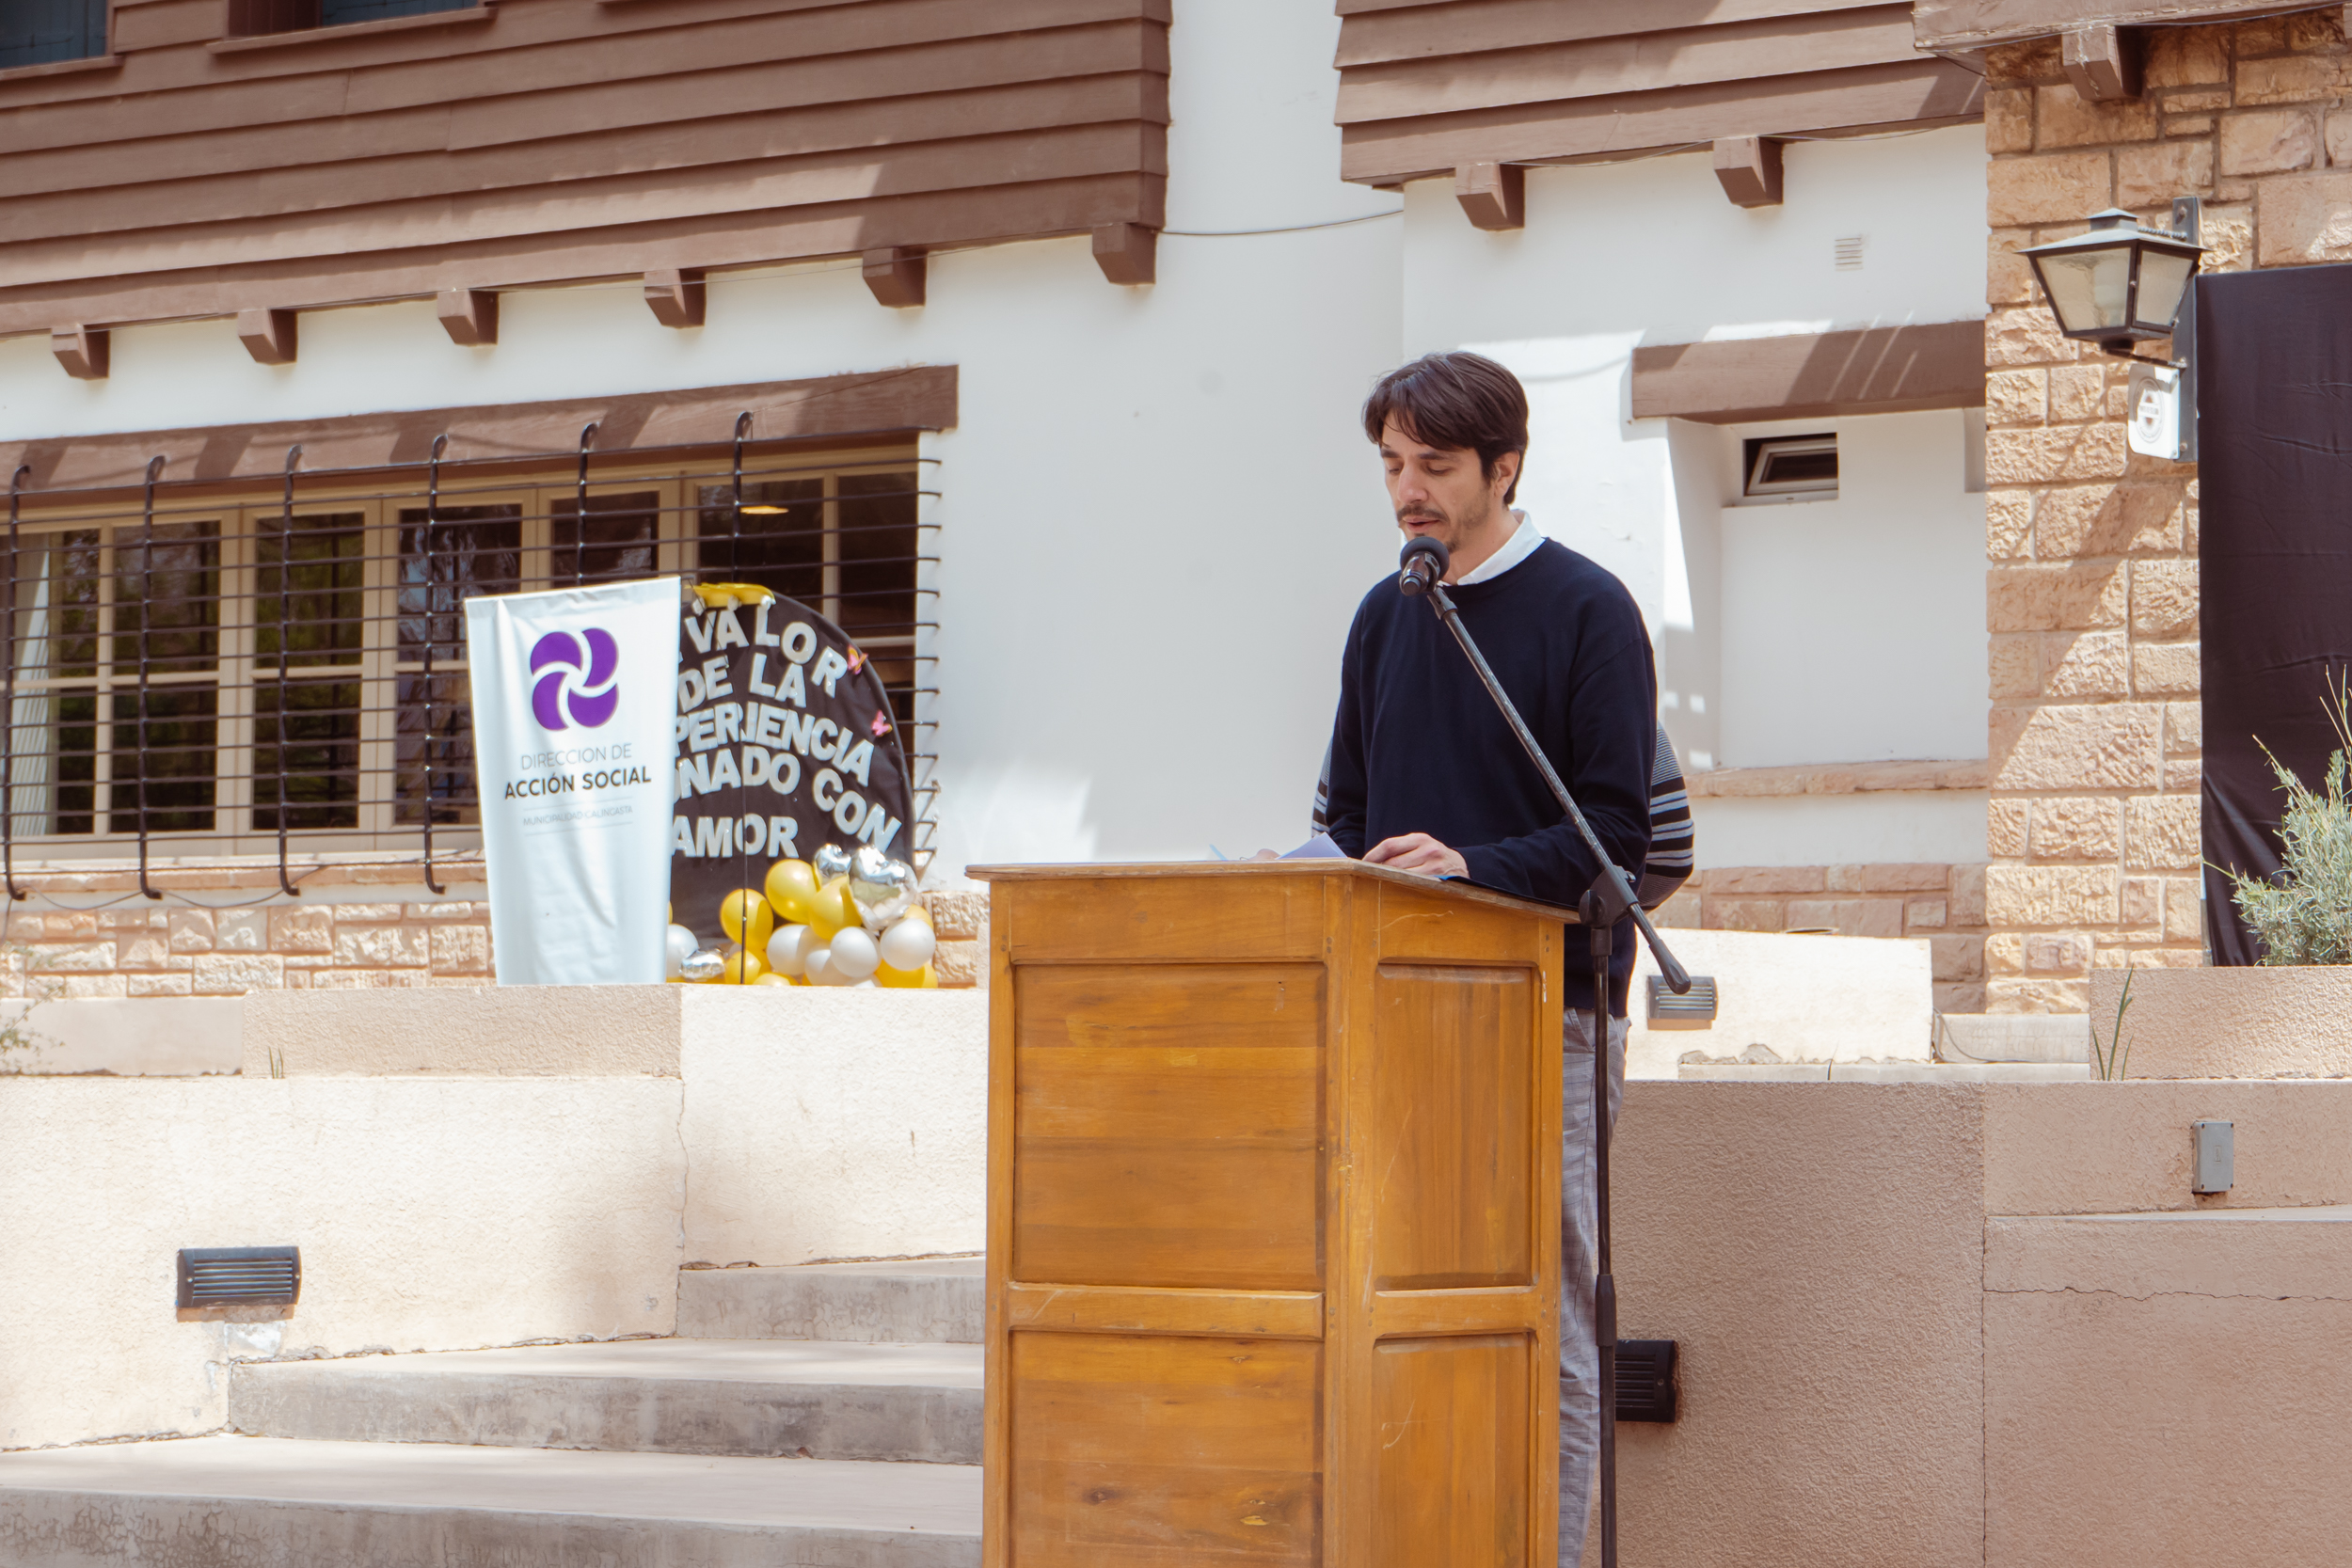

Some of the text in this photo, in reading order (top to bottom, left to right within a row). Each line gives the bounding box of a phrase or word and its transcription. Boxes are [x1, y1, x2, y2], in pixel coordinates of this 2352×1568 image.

[685, 602, 848, 698] VALOR
[678, 653, 806, 713] DE LA
[522, 743, 631, 770] DIRECCION DE
[504, 766, 652, 800] ACCIÓN SOCIAL
[673, 745, 901, 854] NADO CON
[672, 814, 799, 858] AMOR
